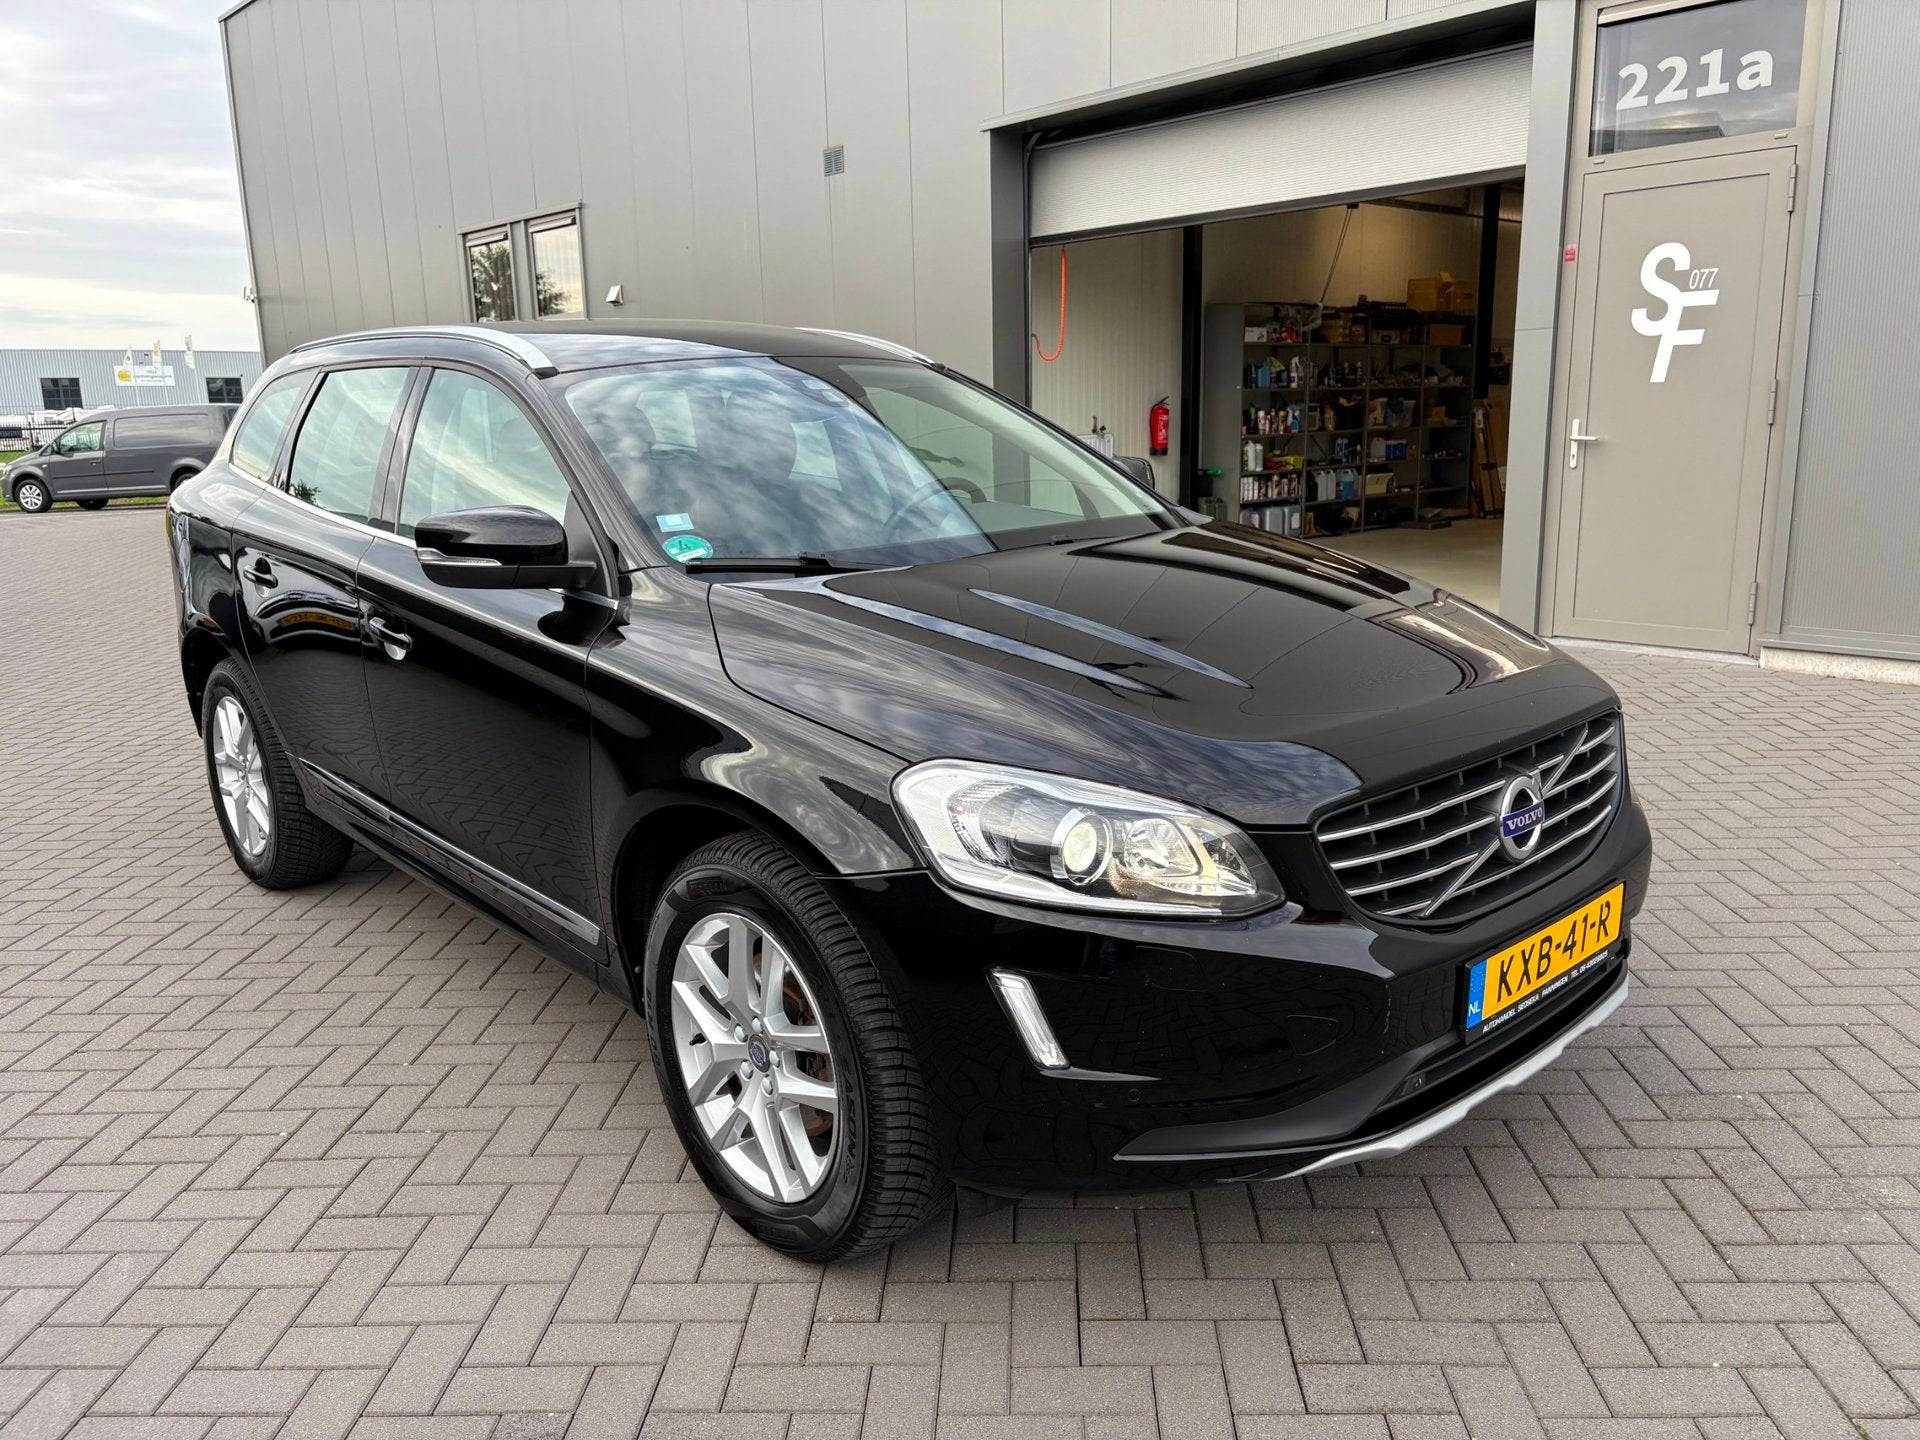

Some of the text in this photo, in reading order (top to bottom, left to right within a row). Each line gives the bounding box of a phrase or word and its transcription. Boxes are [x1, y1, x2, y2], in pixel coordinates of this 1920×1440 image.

[1615, 48, 1774, 112] 221a
[1689, 268, 1719, 290] 077
[1506, 807, 1543, 830] VOLVO
[1497, 900, 1611, 1003] KXB-41-R
[1468, 1002, 1481, 1016] NL
[1482, 1008, 1516, 1034] AUTOHANDEL
